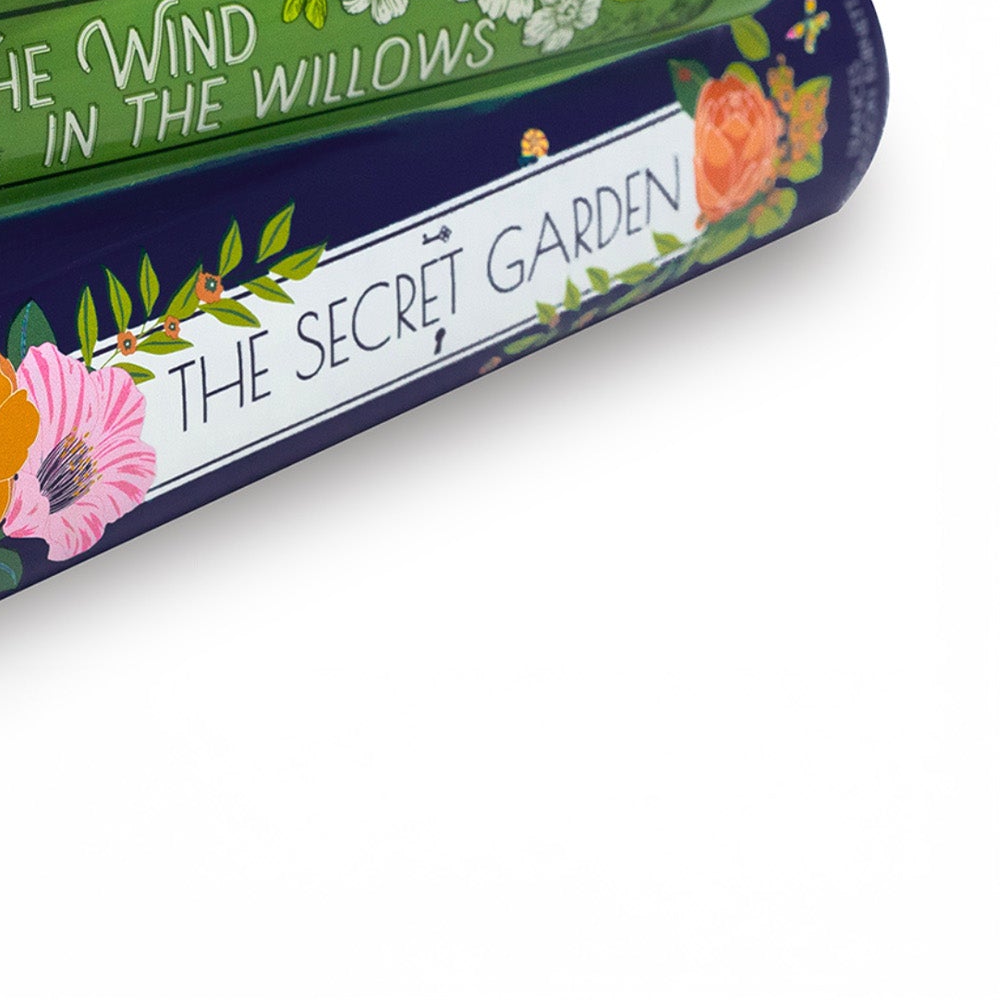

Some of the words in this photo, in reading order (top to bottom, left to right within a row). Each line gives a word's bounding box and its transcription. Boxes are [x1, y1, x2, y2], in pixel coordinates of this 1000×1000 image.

[44, 104, 99, 167] IN
[125, 75, 228, 148] THE
[252, 18, 497, 119] WILLOWS
[168, 330, 272, 432] THE
[295, 247, 464, 382] SECRET
[486, 154, 682, 294] GARDEN
